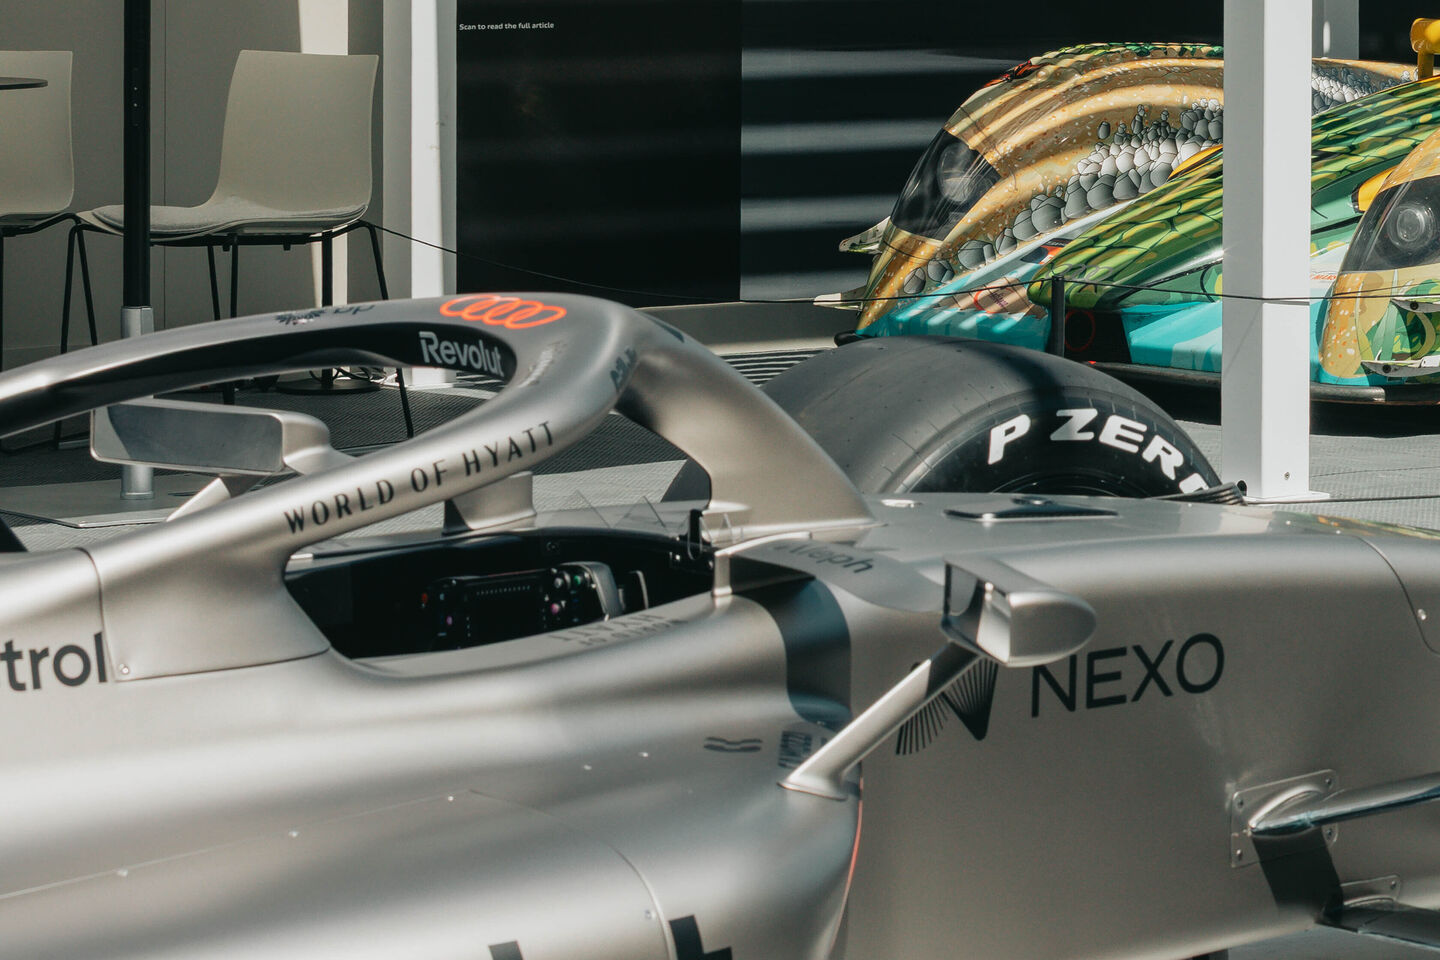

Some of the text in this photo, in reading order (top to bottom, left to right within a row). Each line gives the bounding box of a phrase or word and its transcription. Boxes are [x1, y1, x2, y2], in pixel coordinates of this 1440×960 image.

[418, 330, 504, 377] Revolut
[987, 413, 1032, 465] P
[283, 420, 554, 535] WORLD OF HYATT
[0, 631, 107, 692] trol
[1030, 632, 1225, 718] NEXO
